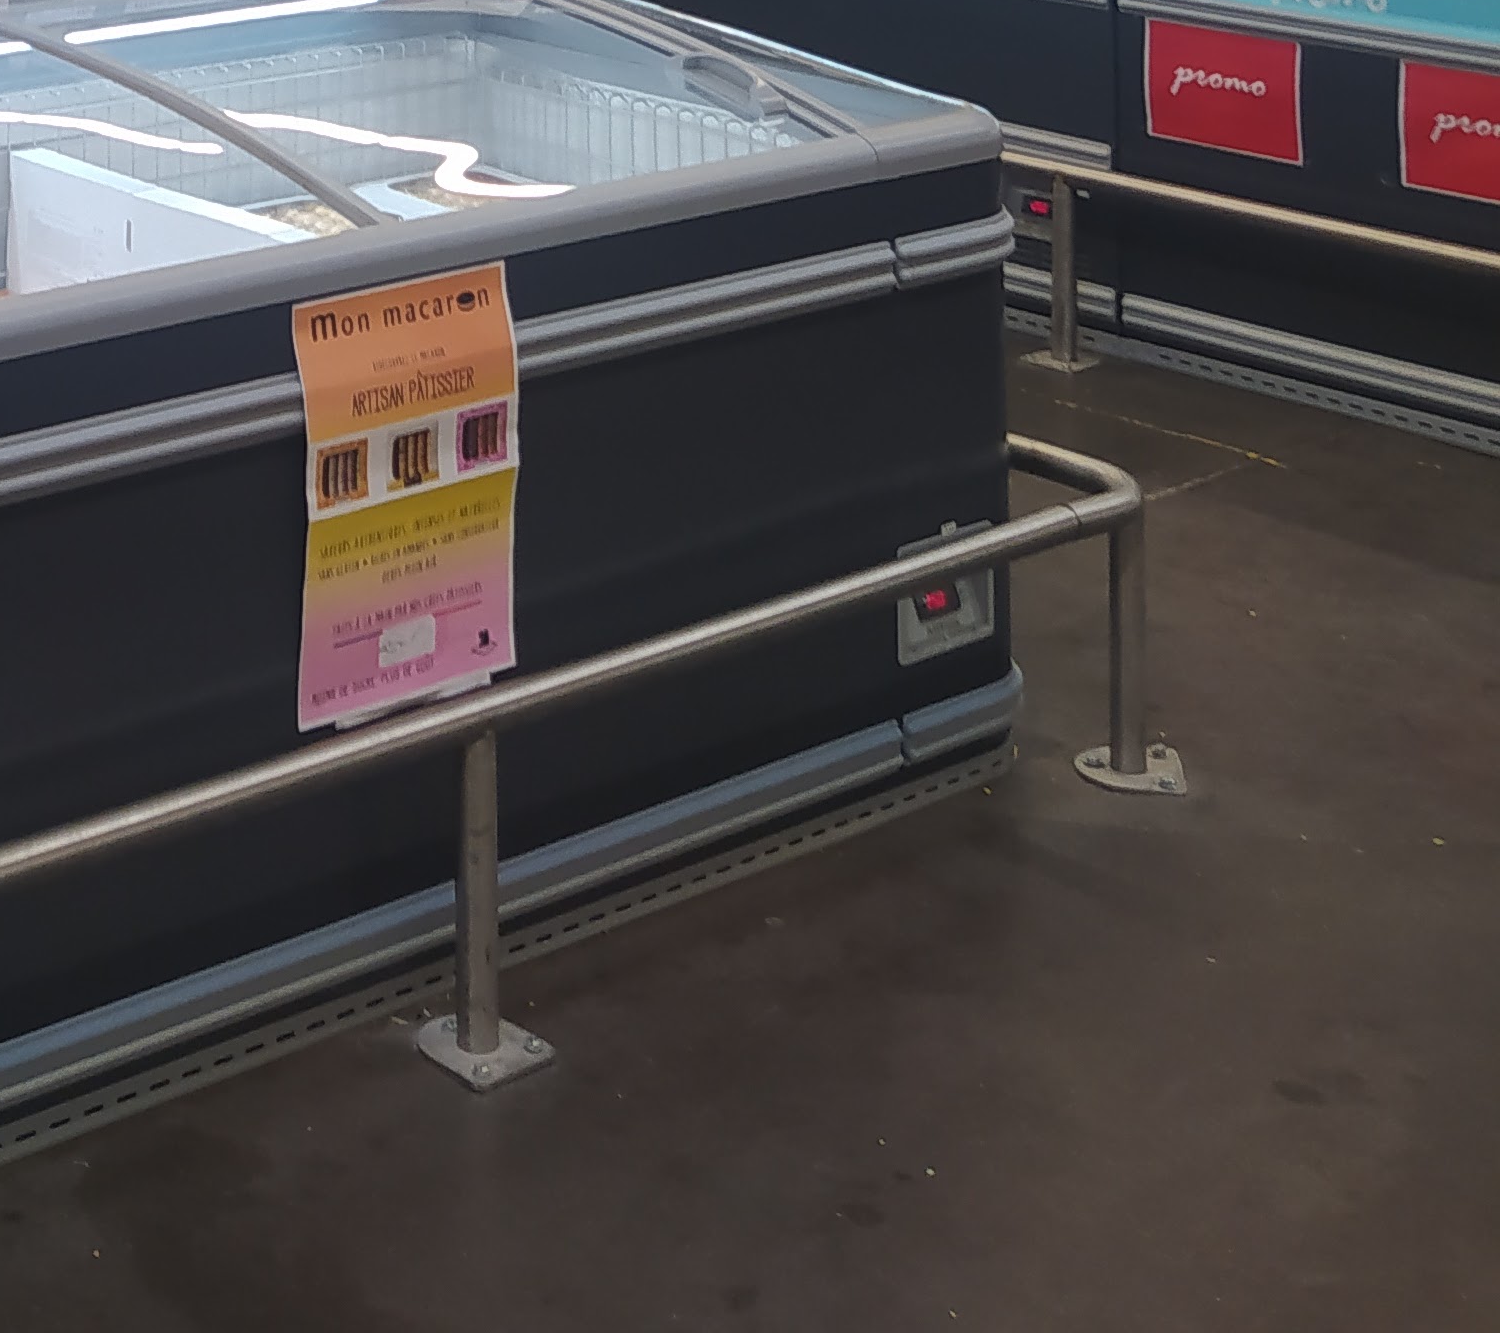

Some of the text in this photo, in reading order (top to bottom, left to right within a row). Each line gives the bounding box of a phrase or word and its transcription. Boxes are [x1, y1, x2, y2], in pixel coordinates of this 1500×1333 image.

[1170, 66, 1267, 98] promo
[352, 366, 475, 418] ARTISAN PÂTISSIER
